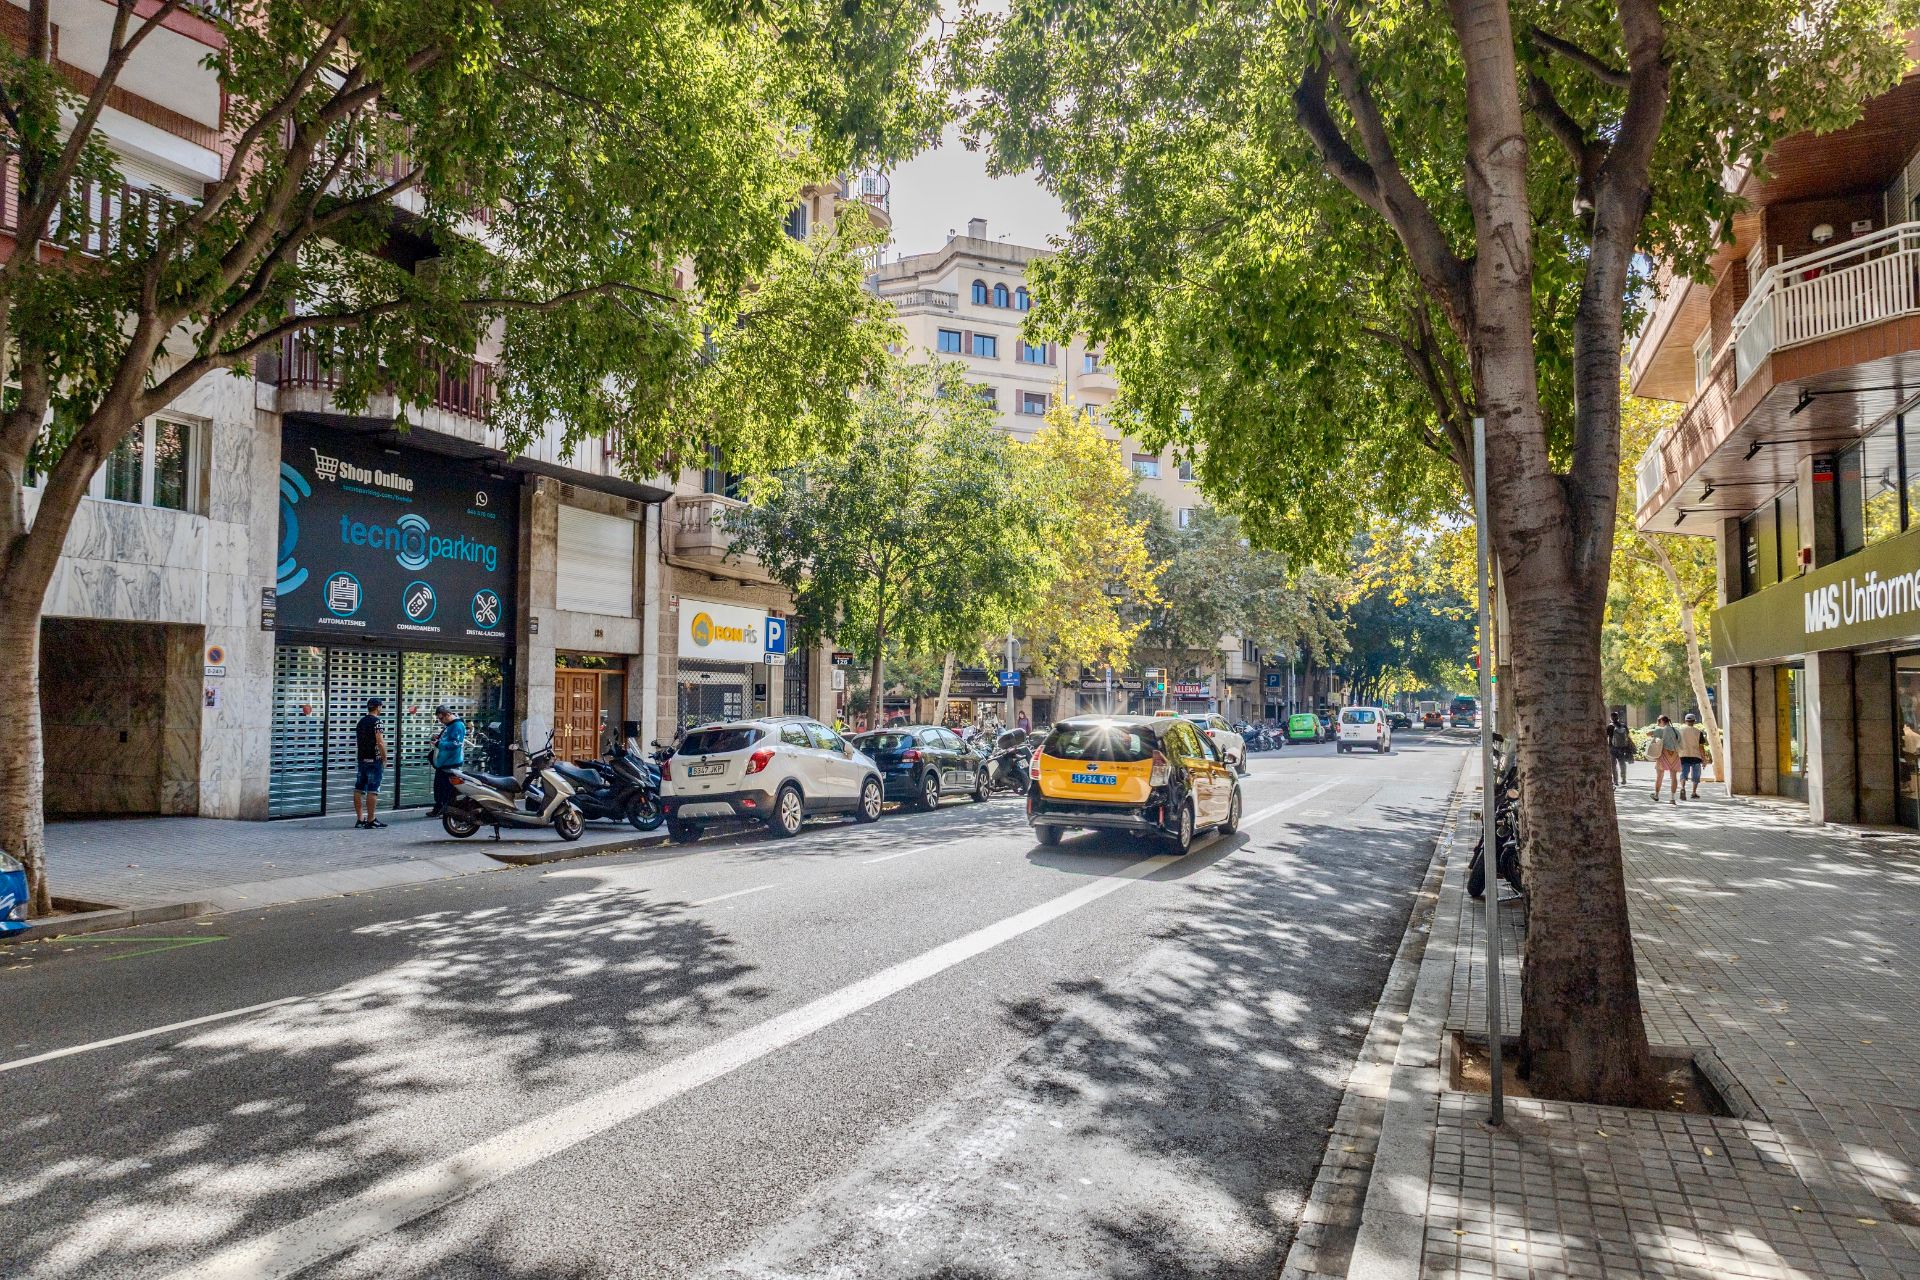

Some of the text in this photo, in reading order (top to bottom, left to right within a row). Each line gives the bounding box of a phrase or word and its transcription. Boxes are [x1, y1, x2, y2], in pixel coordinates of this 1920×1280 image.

[339, 461, 414, 492] Shop Online
[340, 514, 497, 571] tecnoparking
[318, 617, 366, 627] AUTOMATISMES
[1805, 583, 1840, 633] MAS
[396, 623, 441, 633] COMANDAMENTS
[768, 621, 782, 649] P
[1270, 675, 1277, 686] P
